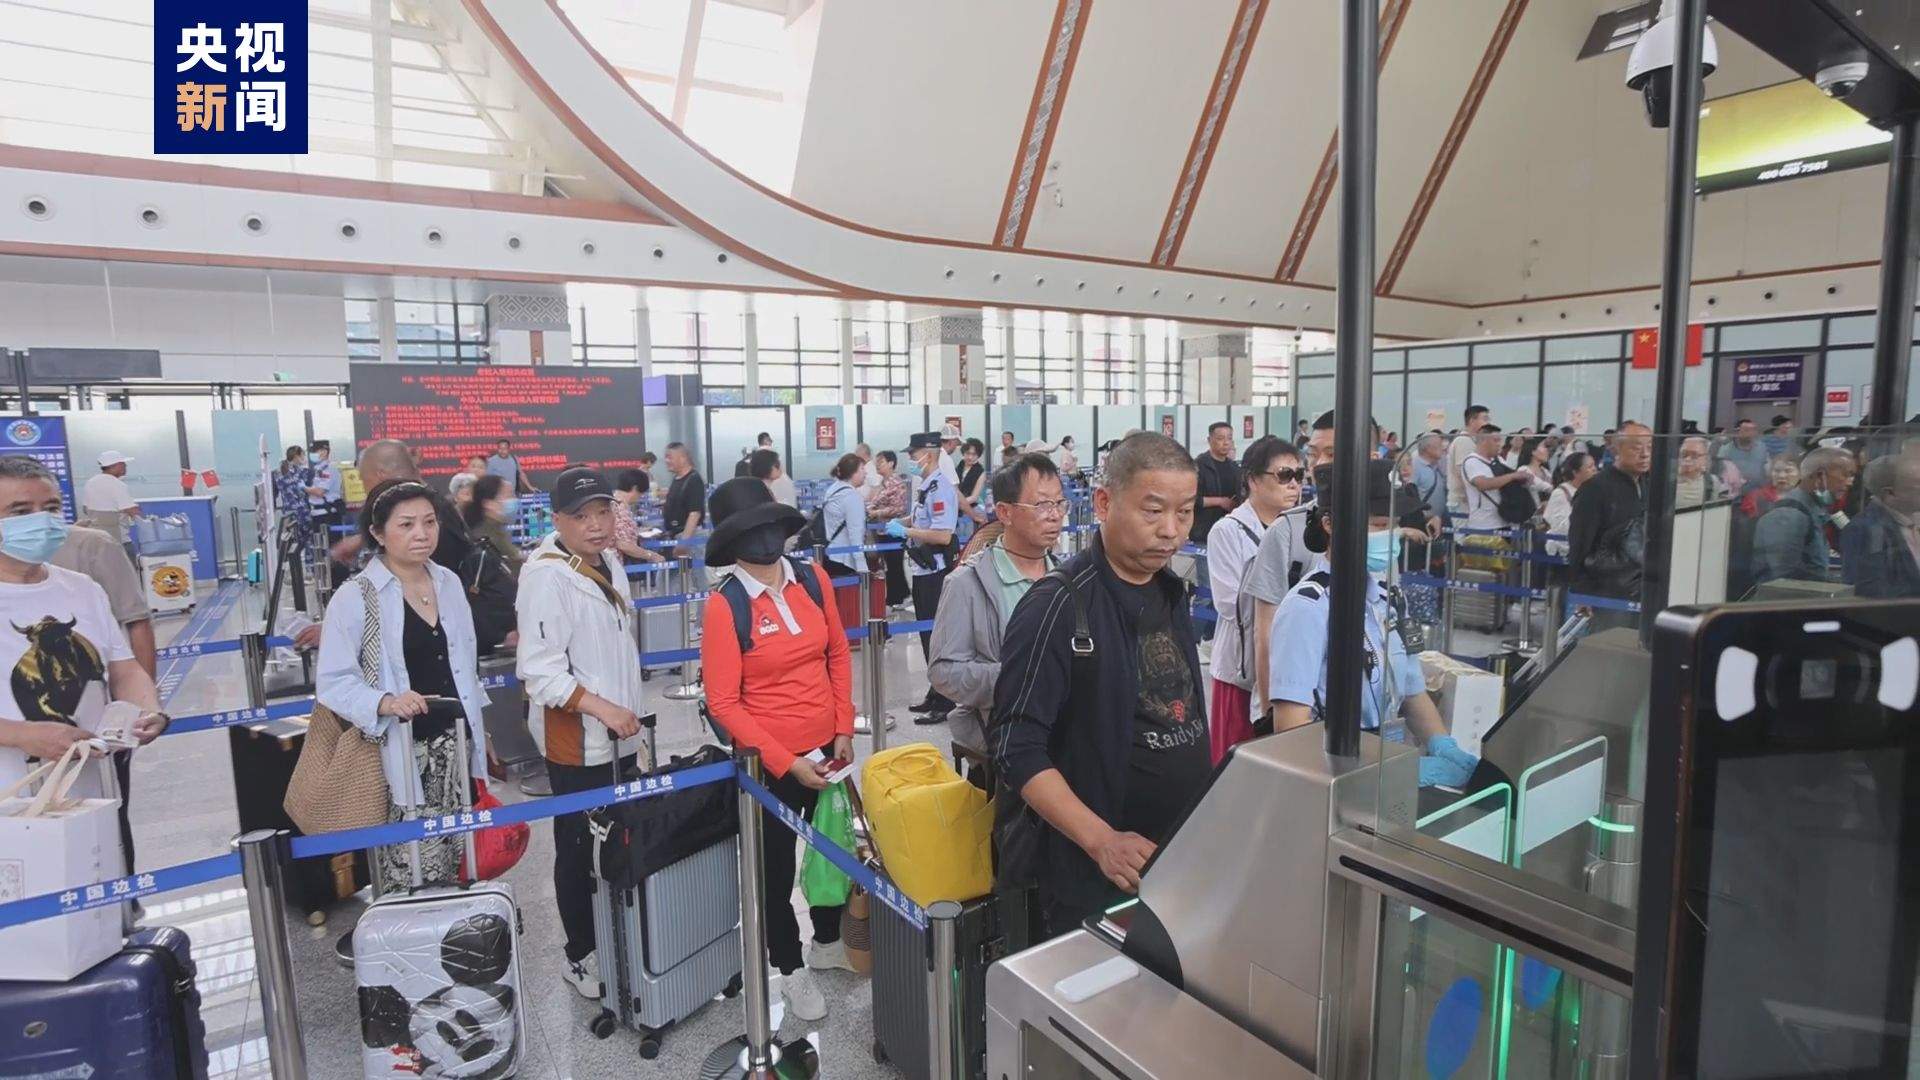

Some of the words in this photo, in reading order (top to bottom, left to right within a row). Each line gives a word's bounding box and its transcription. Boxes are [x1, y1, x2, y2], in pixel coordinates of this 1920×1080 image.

[212, 707, 267, 723] 中国边检
[614, 774, 673, 797] 中国边检
[423, 809, 492, 831] 中国边检
[60, 873, 156, 906] 中国边检
